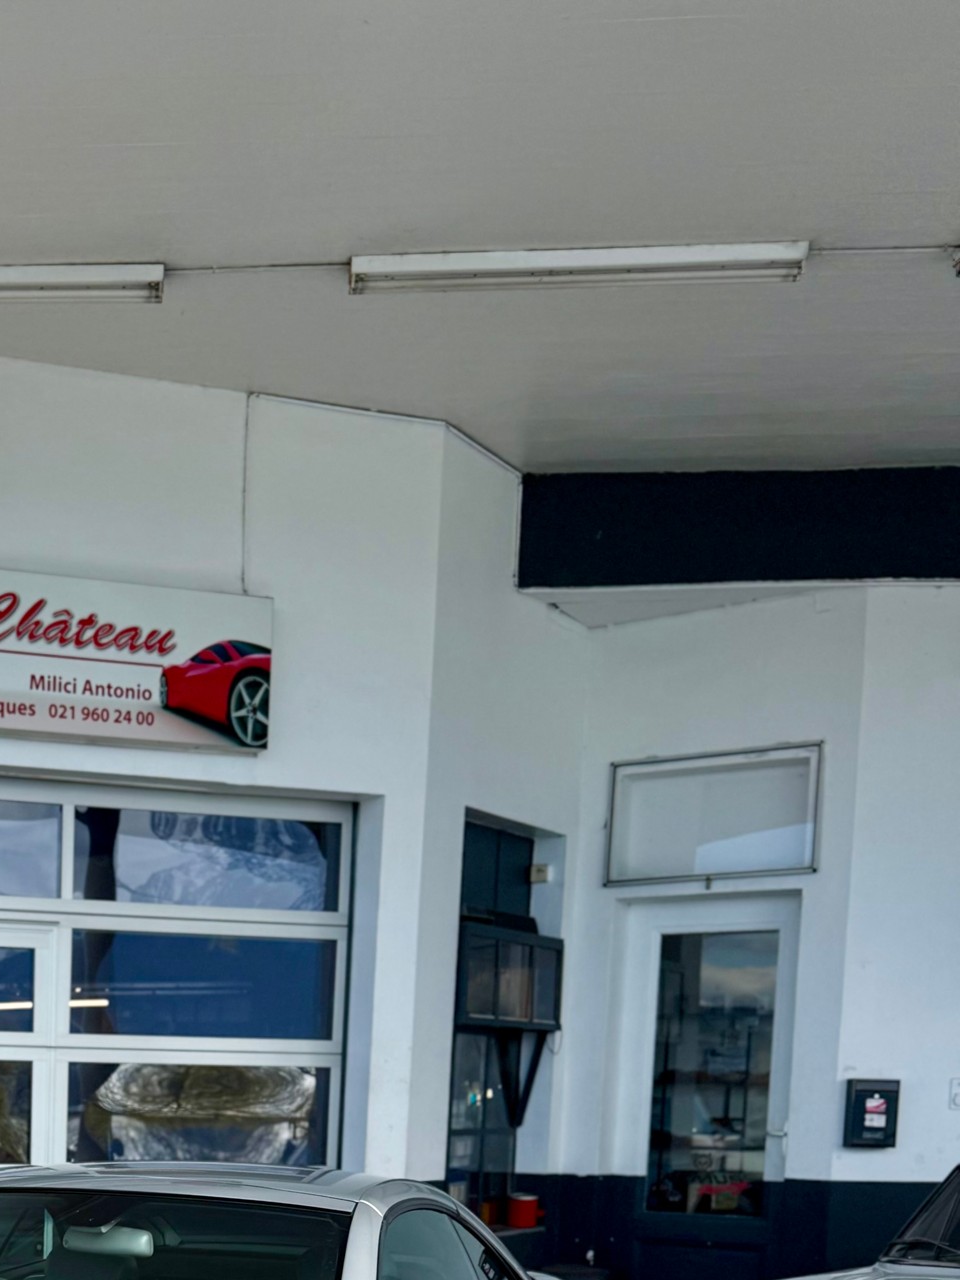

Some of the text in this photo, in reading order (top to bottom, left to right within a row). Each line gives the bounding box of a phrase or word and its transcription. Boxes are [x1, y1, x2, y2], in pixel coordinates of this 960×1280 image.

[29, 674, 152, 701] Milici Antonio
[48, 703, 155, 726] 021 960 24 00
